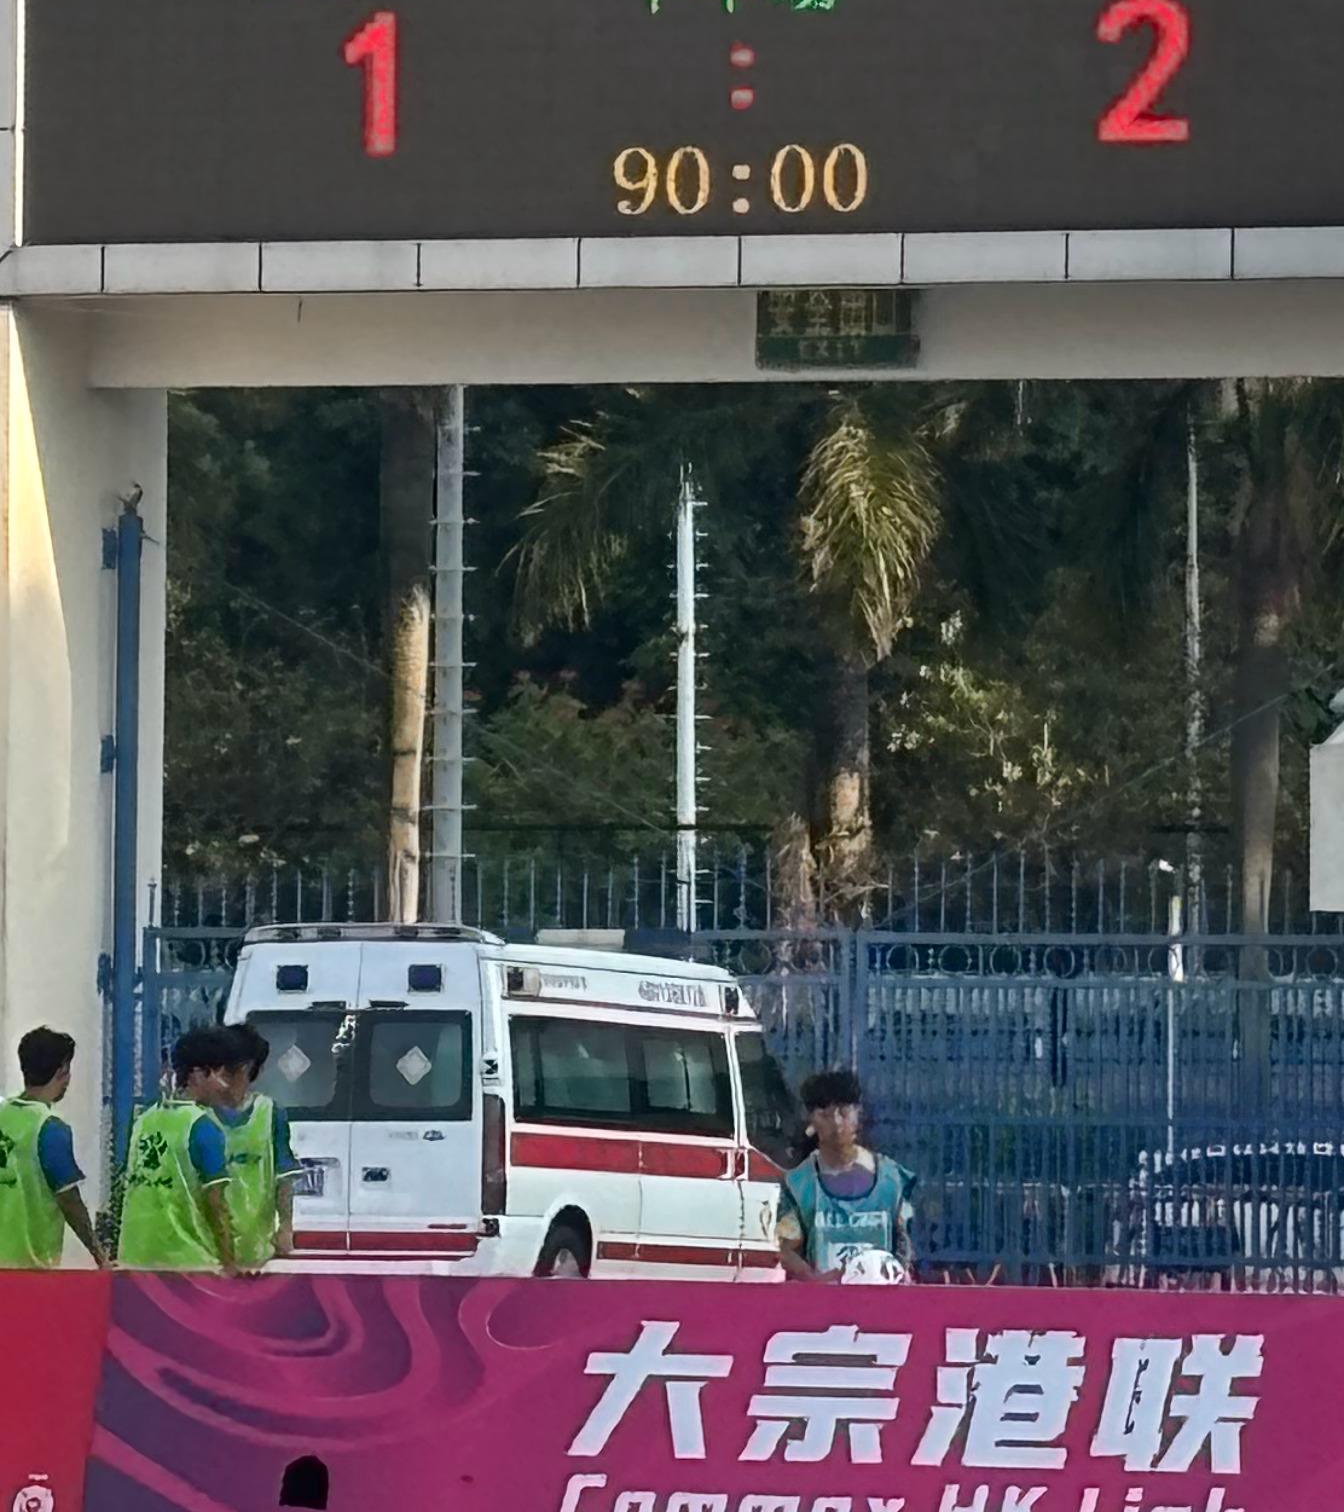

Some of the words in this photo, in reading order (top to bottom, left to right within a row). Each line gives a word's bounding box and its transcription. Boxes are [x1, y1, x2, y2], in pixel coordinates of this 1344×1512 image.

[343, 11, 397, 157] 1
[613, 143, 868, 215] 90:00
[567, 1320, 1265, 1474] 大宗港联
